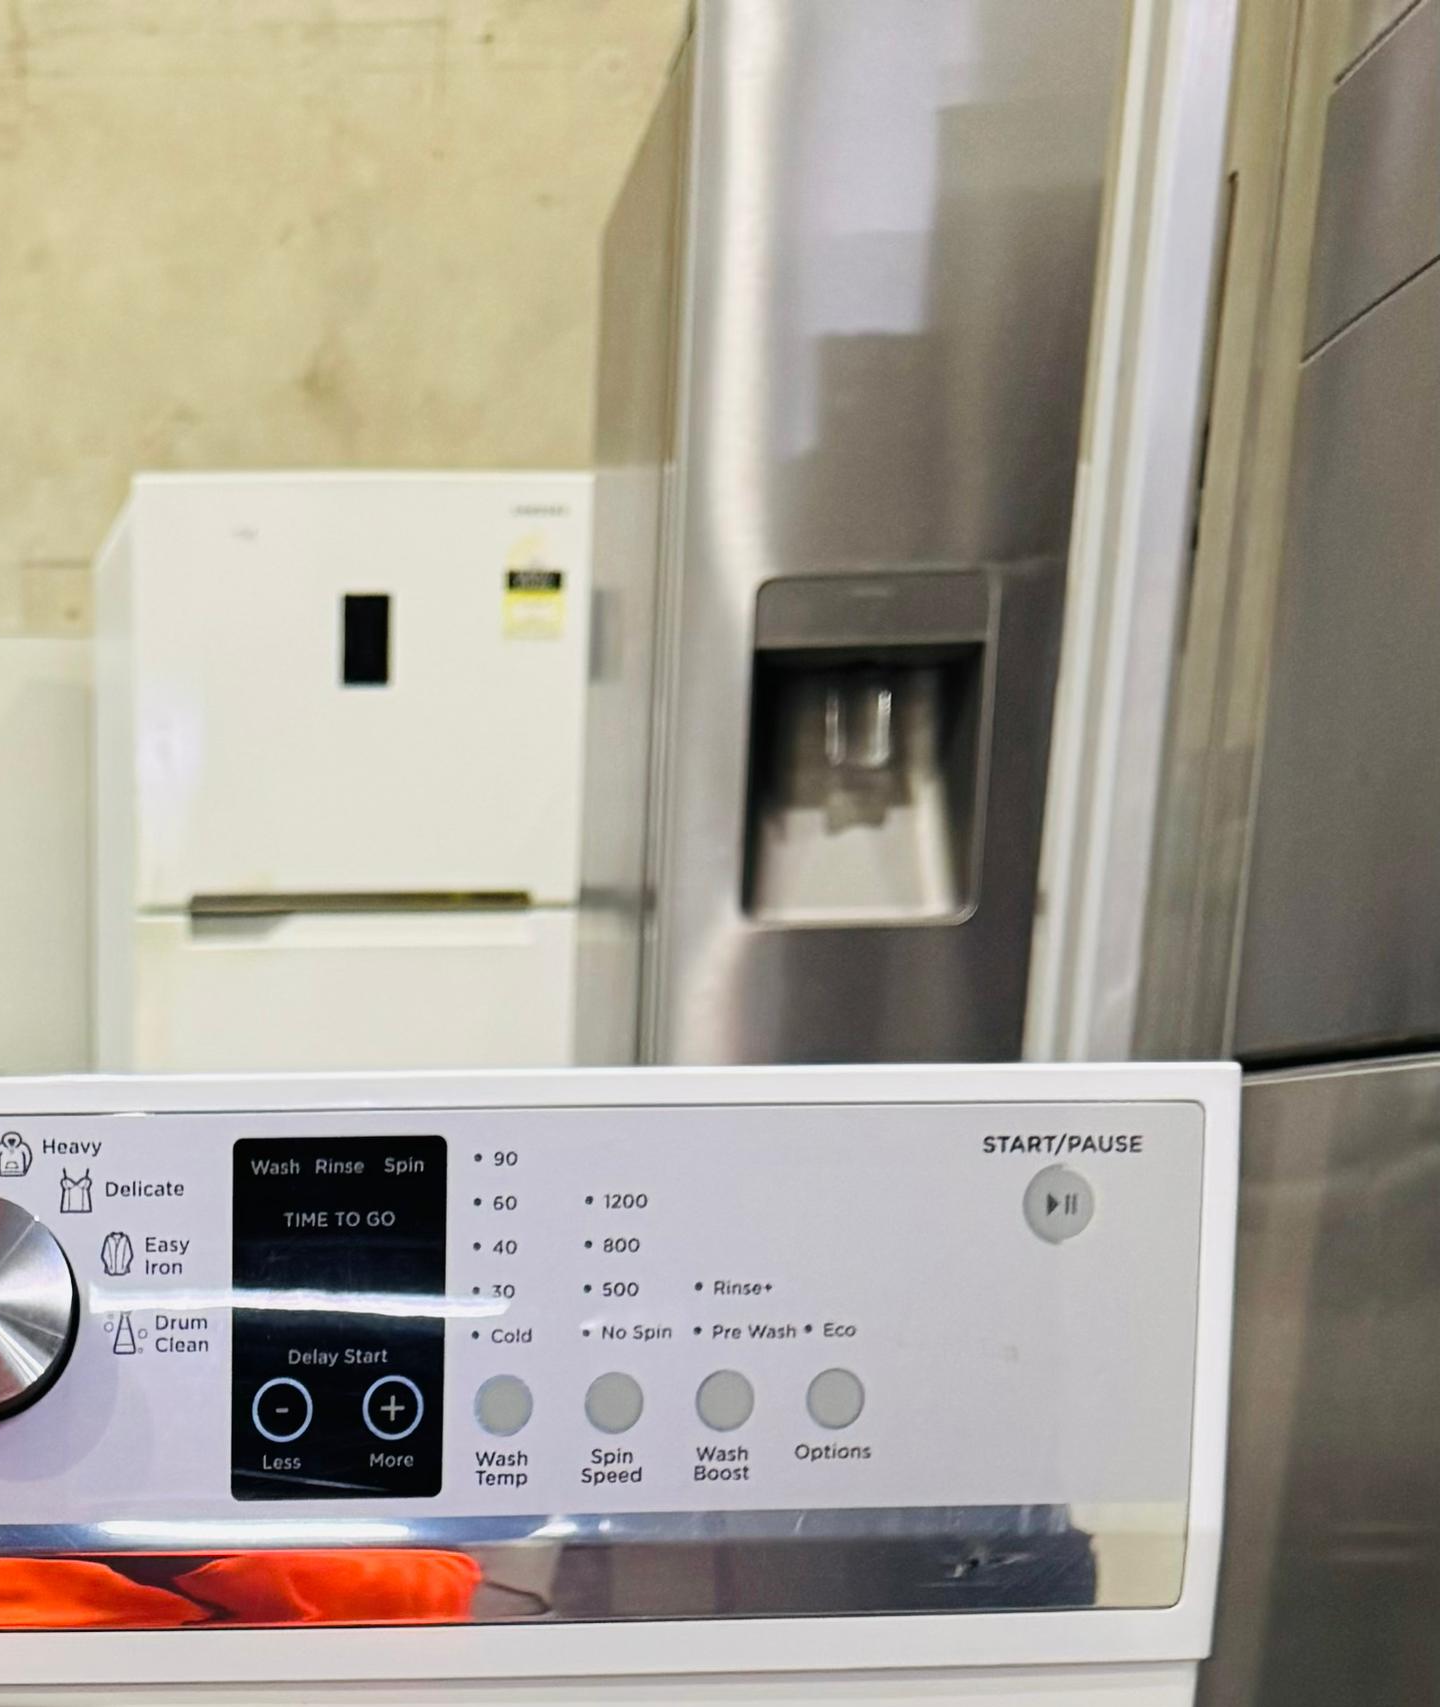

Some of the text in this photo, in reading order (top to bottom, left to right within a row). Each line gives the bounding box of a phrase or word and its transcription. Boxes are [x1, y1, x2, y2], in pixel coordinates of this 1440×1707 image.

[43, 1139, 101, 1157] Heavy
[984, 1134, 1142, 1155] START/PAUSE
[251, 1157, 424, 1175] Wash Rinse Spin
[494, 1151, 517, 1166] 90
[106, 1181, 184, 1197] Delicate
[494, 1196, 517, 1210] 60
[604, 1194, 648, 1210] 1200
[284, 1211, 395, 1227] TIME TO GO
[146, 1237, 189, 1255] Easy
[493, 1240, 517, 1254] 40
[604, 1238, 640, 1252] 800
[146, 1260, 182, 1274] Iron
[493, 1285, 515, 1298] 30
[603, 1282, 639, 1296] 500
[714, 1281, 772, 1295] Rinse+
[156, 1315, 207, 1330] Drum
[824, 1323, 856, 1337] Eco
[491, 1328, 532, 1343] Cold
[602, 1325, 671, 1341] No Spin
[713, 1325, 796, 1339] Pre Wash
[156, 1337, 208, 1352] Clean
[289, 1349, 387, 1367] Delay Start
[370, 1453, 413, 1467] More
[476, 1451, 527, 1466] Wash
[592, 1448, 633, 1466] Spin
[697, 1446, 748, 1461] Wash
[795, 1444, 871, 1462] Options
[263, 1455, 301, 1469] Less
[476, 1470, 527, 1488] Temp
[582, 1467, 642, 1485] Speed
[694, 1466, 749, 1481] Boost
